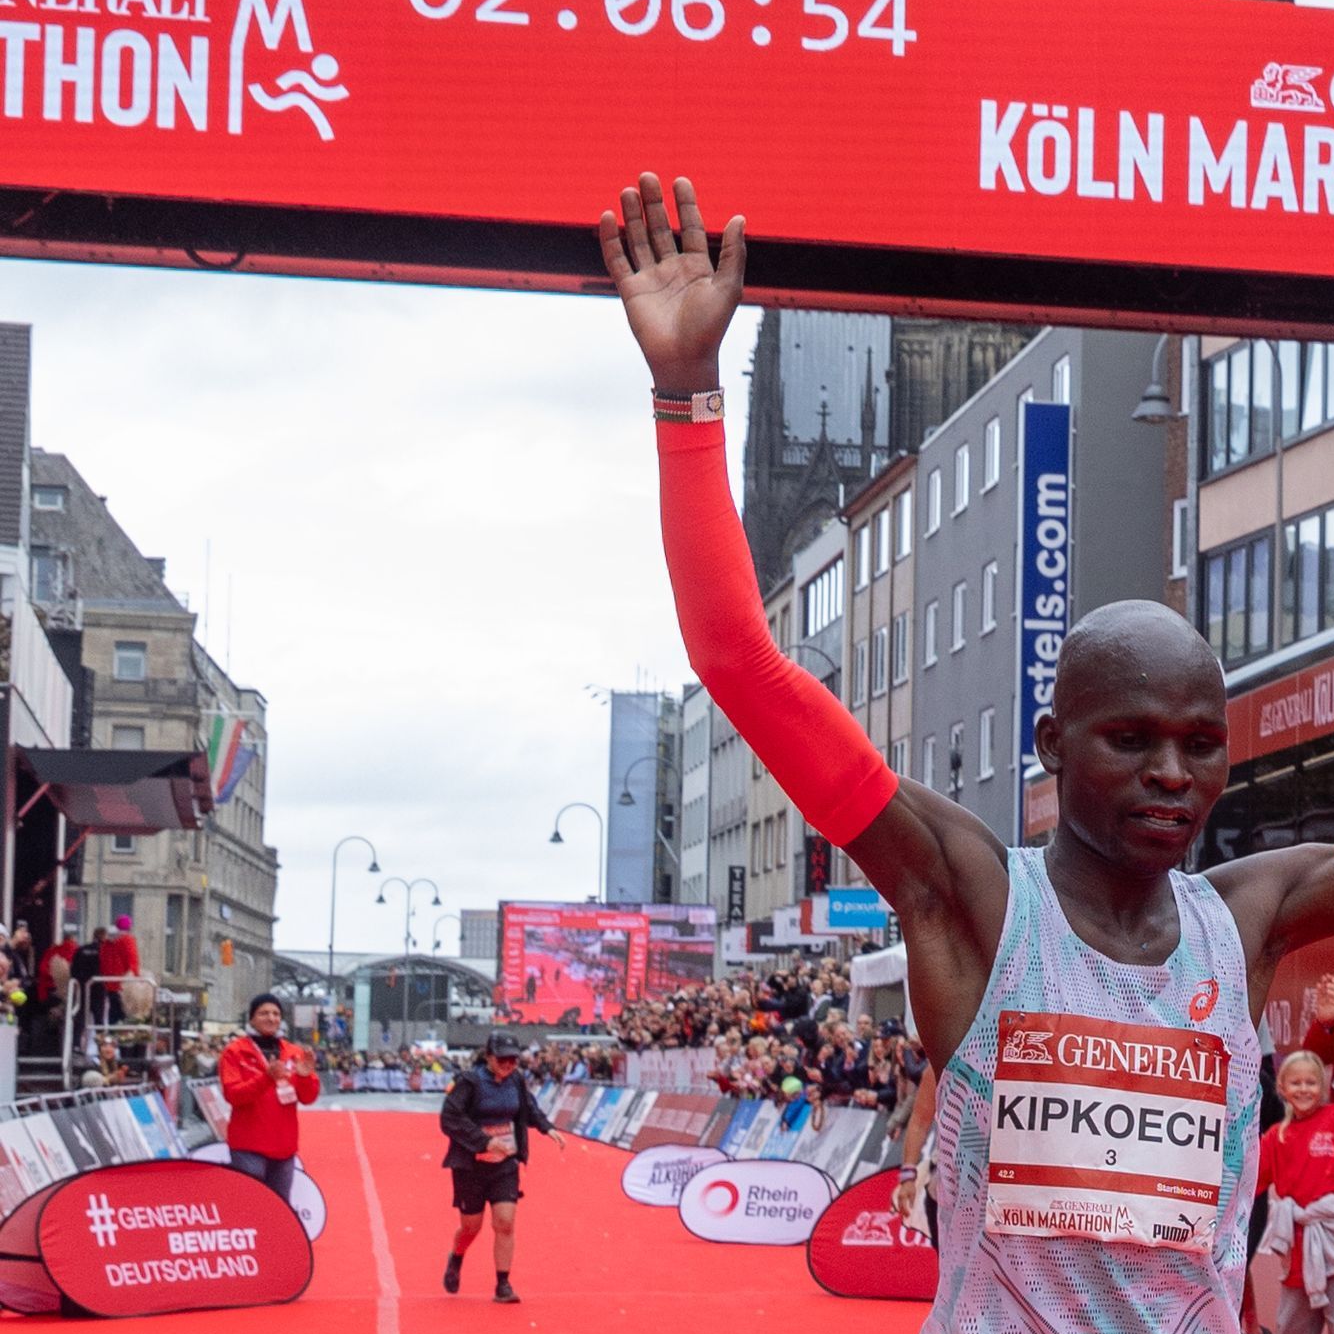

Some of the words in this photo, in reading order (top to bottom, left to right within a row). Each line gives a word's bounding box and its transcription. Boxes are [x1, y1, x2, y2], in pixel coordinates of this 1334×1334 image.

[978, 98, 1165, 203] KÖLN
[1021, 472, 1068, 766] stels.com
[1057, 1033, 1223, 1088] GENERALI
[996, 1094, 1222, 1153] KIPKOECH
[1105, 1149, 1117, 1166] 3
[747, 1185, 799, 1203] Rhein
[1156, 1182, 1196, 1197] Startblock
[1197, 1189, 1213, 1200] ROT
[744, 1201, 814, 1222] Energie
[1002, 1207, 1037, 1228] KÖLN
[1038, 1211, 1112, 1233] MARATHON
[1064, 1200, 1113, 1214] GENERALI
[168, 1228, 258, 1255] BEWEGT
[1152, 1223, 1190, 1244] PUMA
[105, 1255, 259, 1288] DEUTSCHLAND
